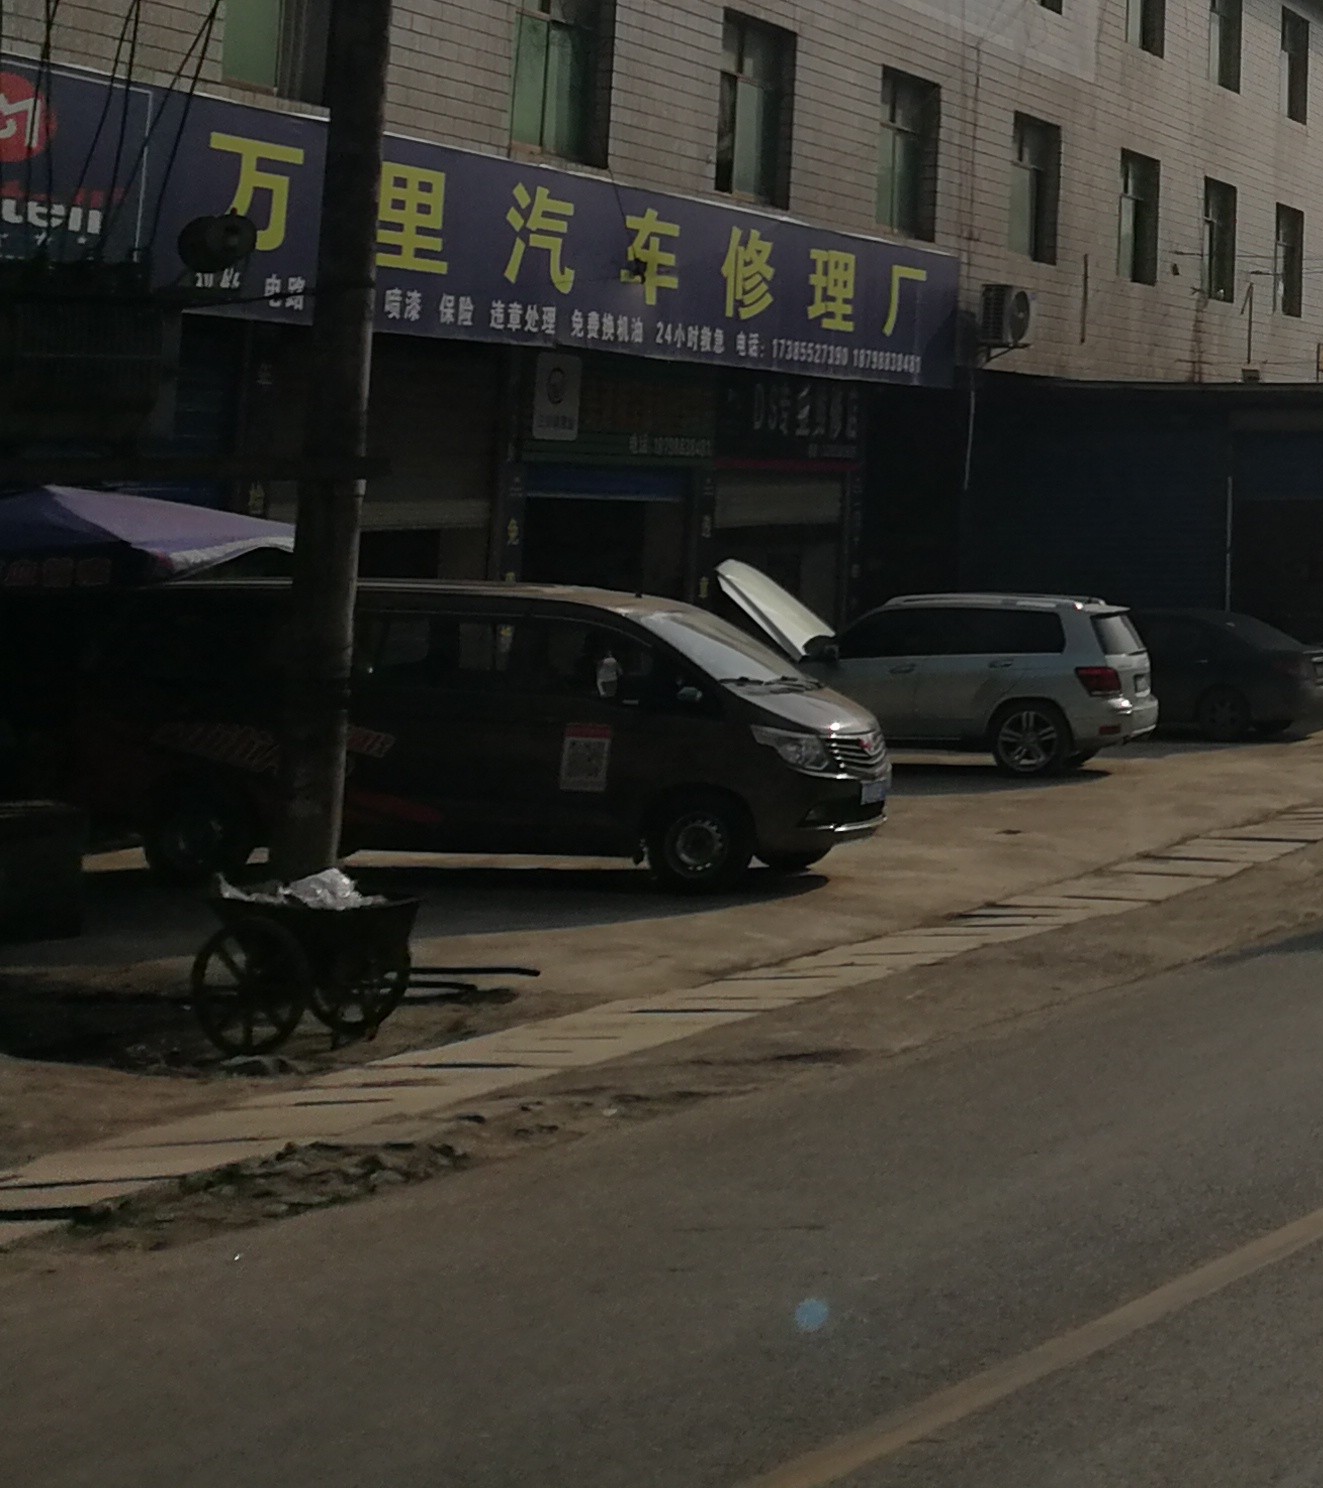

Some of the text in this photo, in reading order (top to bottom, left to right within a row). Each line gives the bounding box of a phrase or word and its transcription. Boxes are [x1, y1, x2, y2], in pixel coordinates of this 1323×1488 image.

[210, 132, 928, 338] 万里汽车修理厂
[384, 288, 422, 322] 喷漆
[439, 292, 475, 326] 保险
[489, 299, 557, 335] 违章处理
[571, 308, 643, 344] 免费换机油
